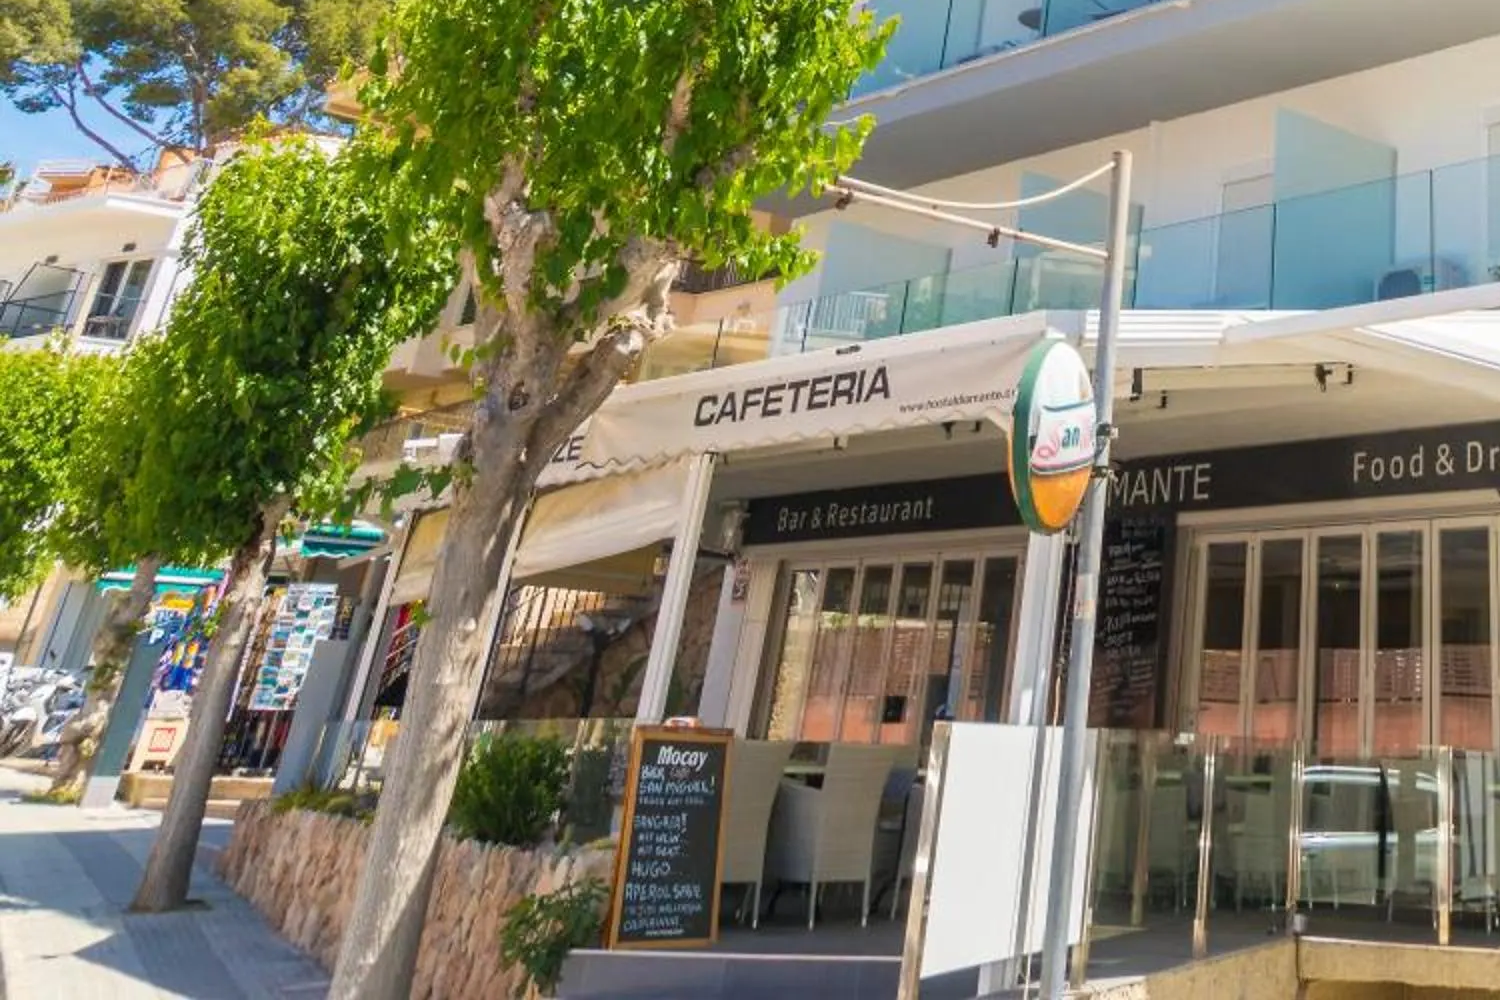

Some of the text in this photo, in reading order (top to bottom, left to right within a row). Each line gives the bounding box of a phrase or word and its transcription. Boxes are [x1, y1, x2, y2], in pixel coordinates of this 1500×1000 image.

[693, 365, 891, 427] CAFETERIA
[1353, 445, 1424, 483] Food
[1435, 443, 1454, 476] &
[1106, 463, 1212, 508] MANTE
[777, 496, 934, 532] Bar & Restaurant
[657, 745, 709, 772] Mocay
